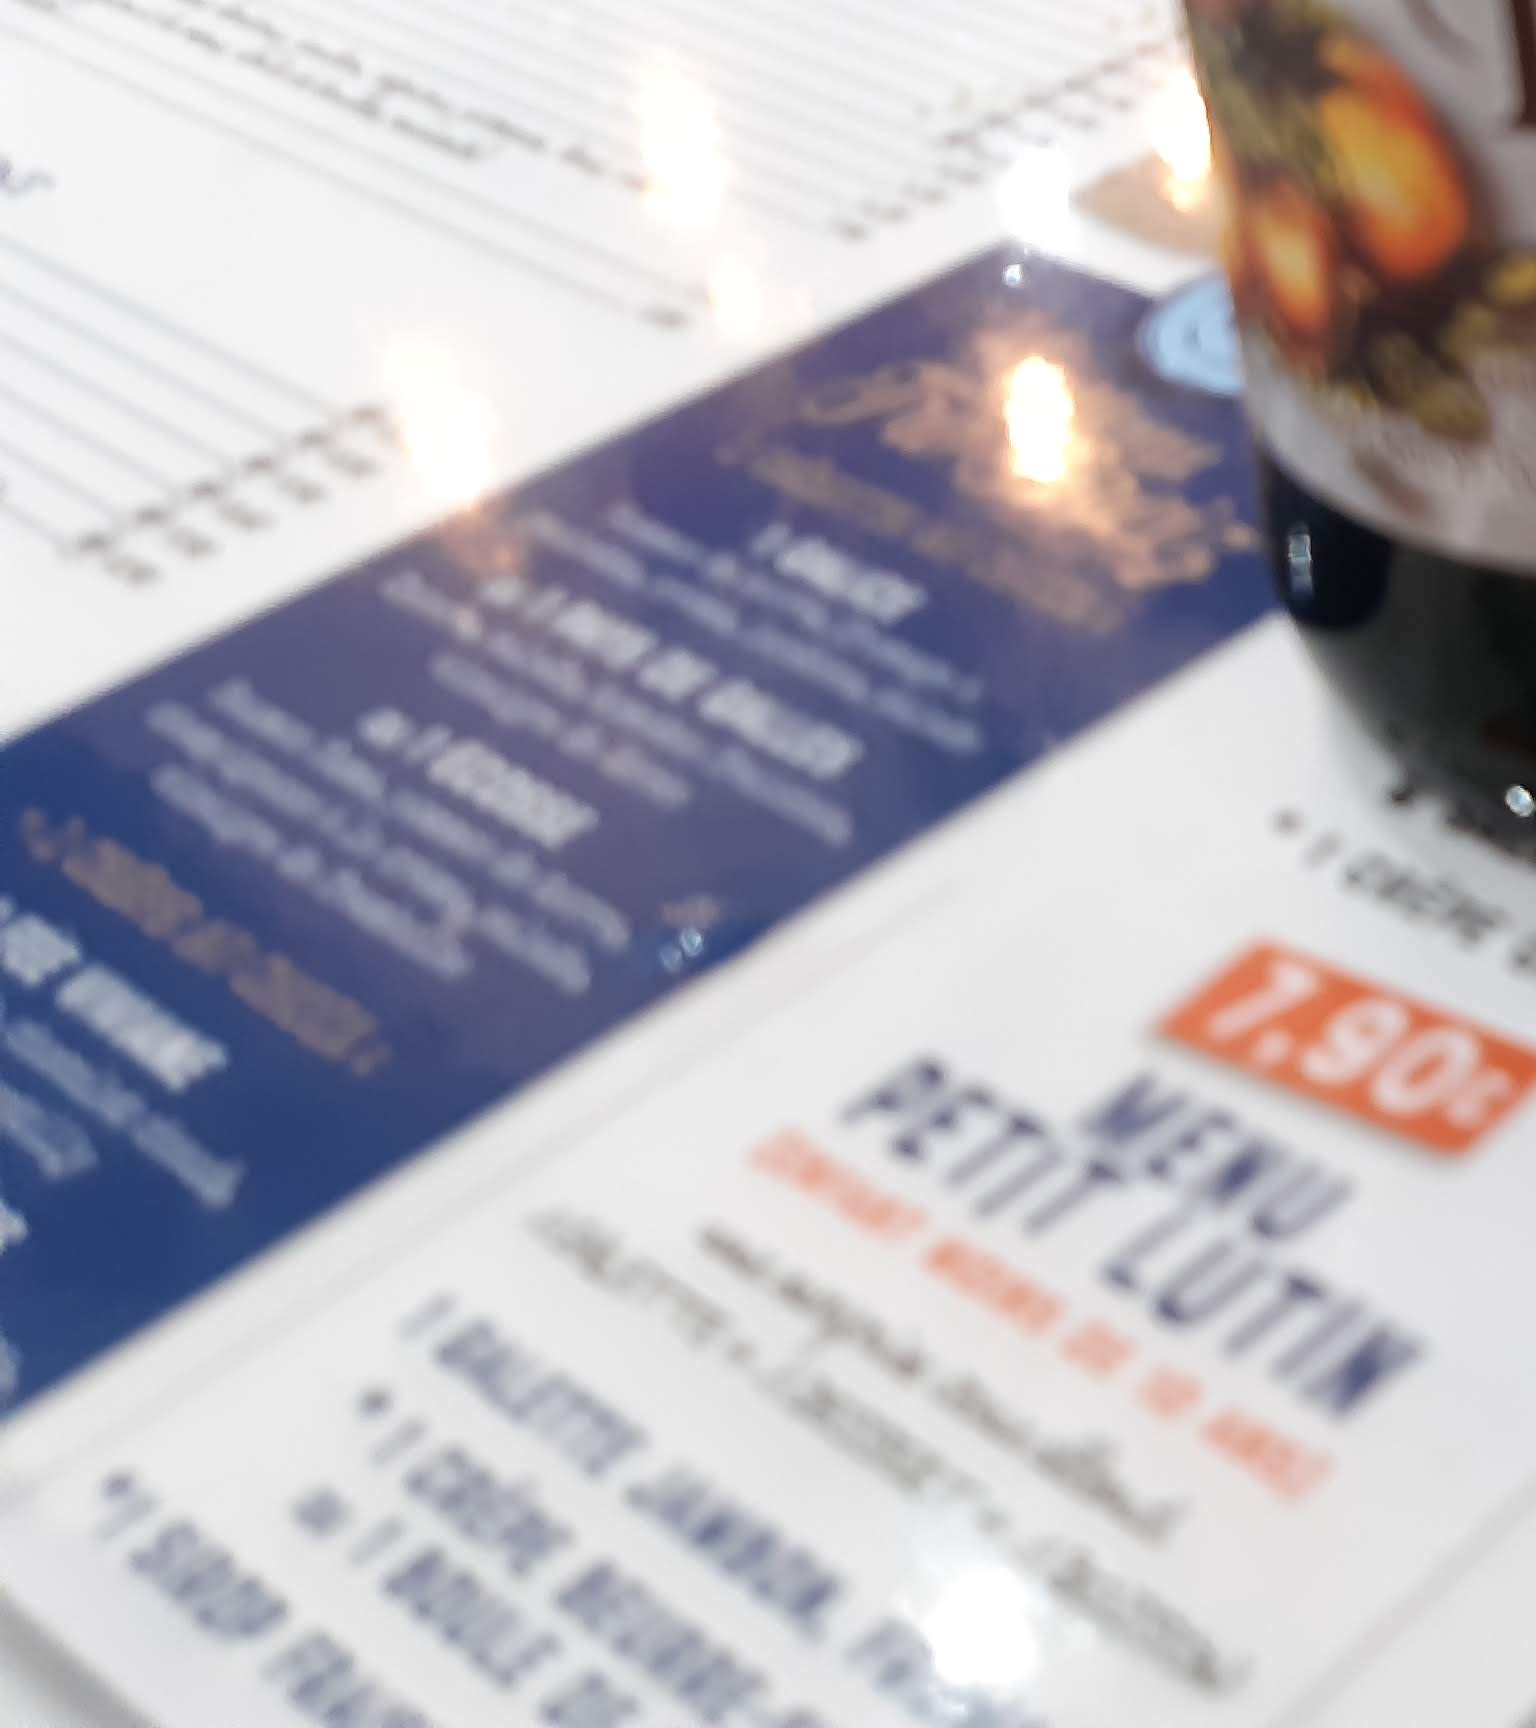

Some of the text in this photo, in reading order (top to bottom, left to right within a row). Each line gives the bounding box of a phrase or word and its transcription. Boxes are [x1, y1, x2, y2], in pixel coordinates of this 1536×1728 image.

[835, 1054, 1132, 1236] PETIT
[1099, 1209, 1423, 1422] LUTIN
[1078, 1073, 1355, 1244] MENU
